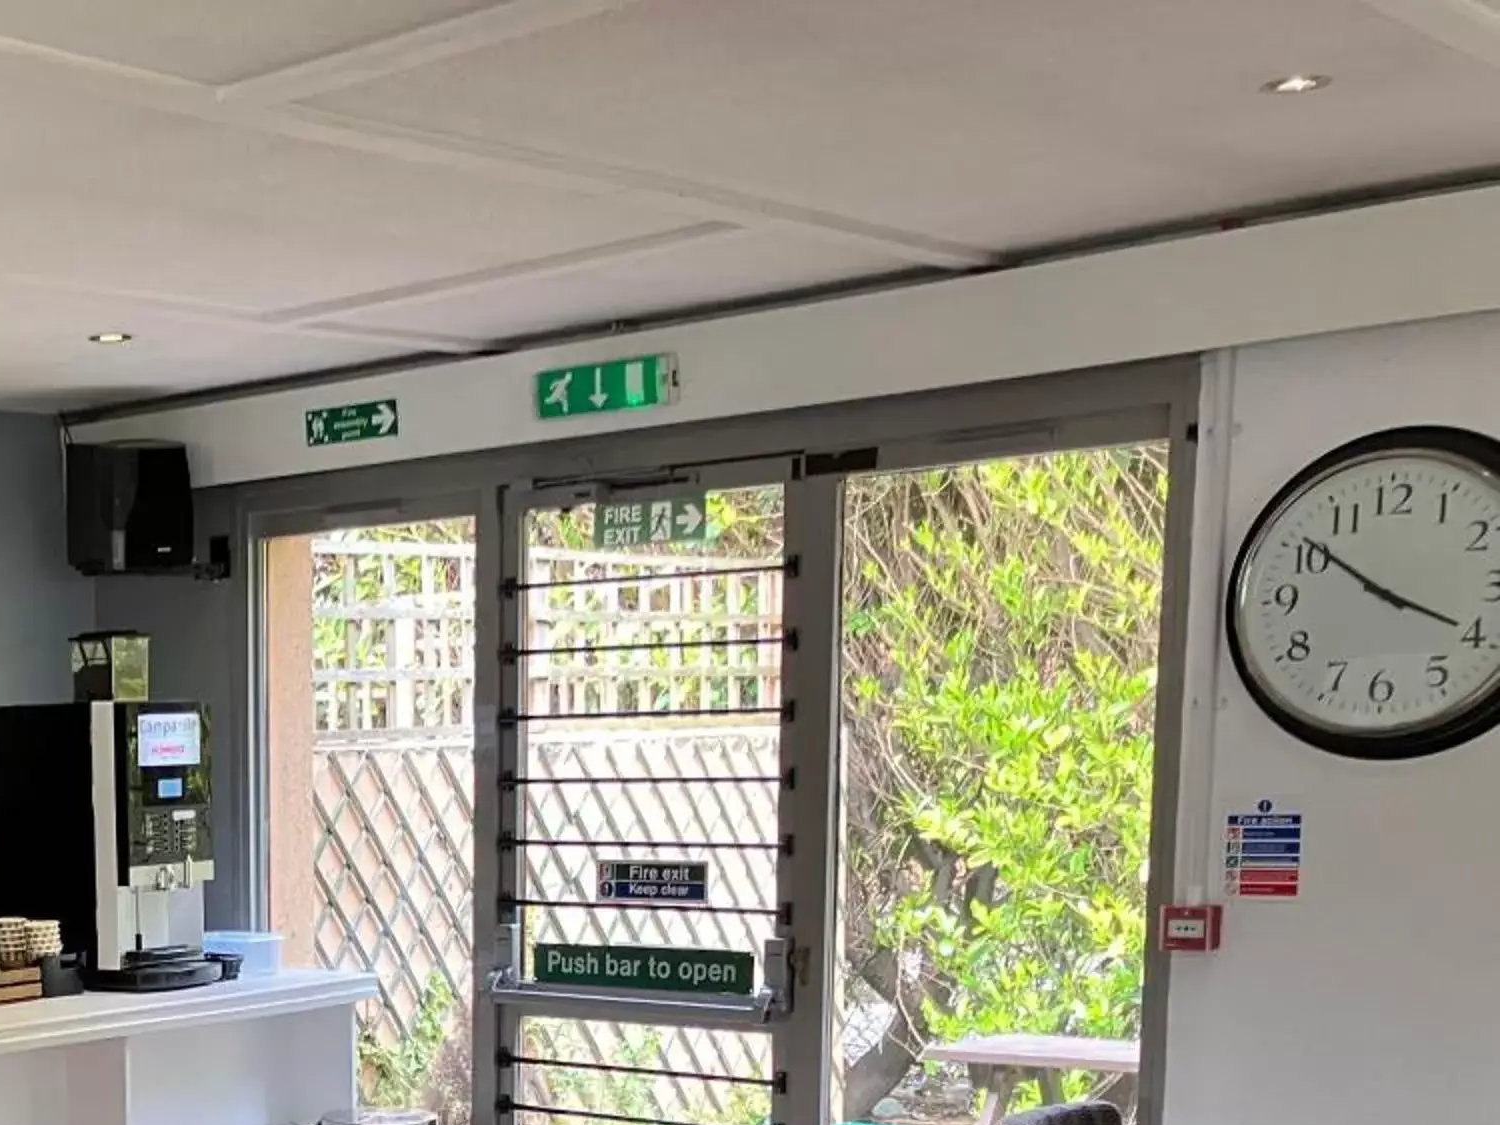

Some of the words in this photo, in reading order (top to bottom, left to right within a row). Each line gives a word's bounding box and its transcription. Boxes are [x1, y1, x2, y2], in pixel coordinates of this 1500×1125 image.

[604, 504, 643, 525] FIRE
[1376, 484, 1414, 516] 12
[1438, 493, 1448, 524] 1
[1333, 504, 1360, 535] 11
[604, 526, 641, 545] EXIT
[1464, 520, 1489, 552] 2
[1295, 543, 1331, 574] 10
[1275, 583, 1299, 616] 9
[1483, 569, 1500, 602] 3
[1286, 630, 1311, 661] 8
[1460, 616, 1486, 649] 4
[1327, 661, 1348, 691] 7
[1368, 669, 1394, 702] 6
[1426, 655, 1449, 687] 5
[629, 865, 658, 880] Fire
[661, 866, 690, 881] exit
[629, 884, 658, 897] Keep
[661, 884, 689, 896] clear
[547, 950, 599, 975] Push
[605, 953, 641, 977] bar
[648, 956, 671, 979] to
[678, 961, 737, 985] open
